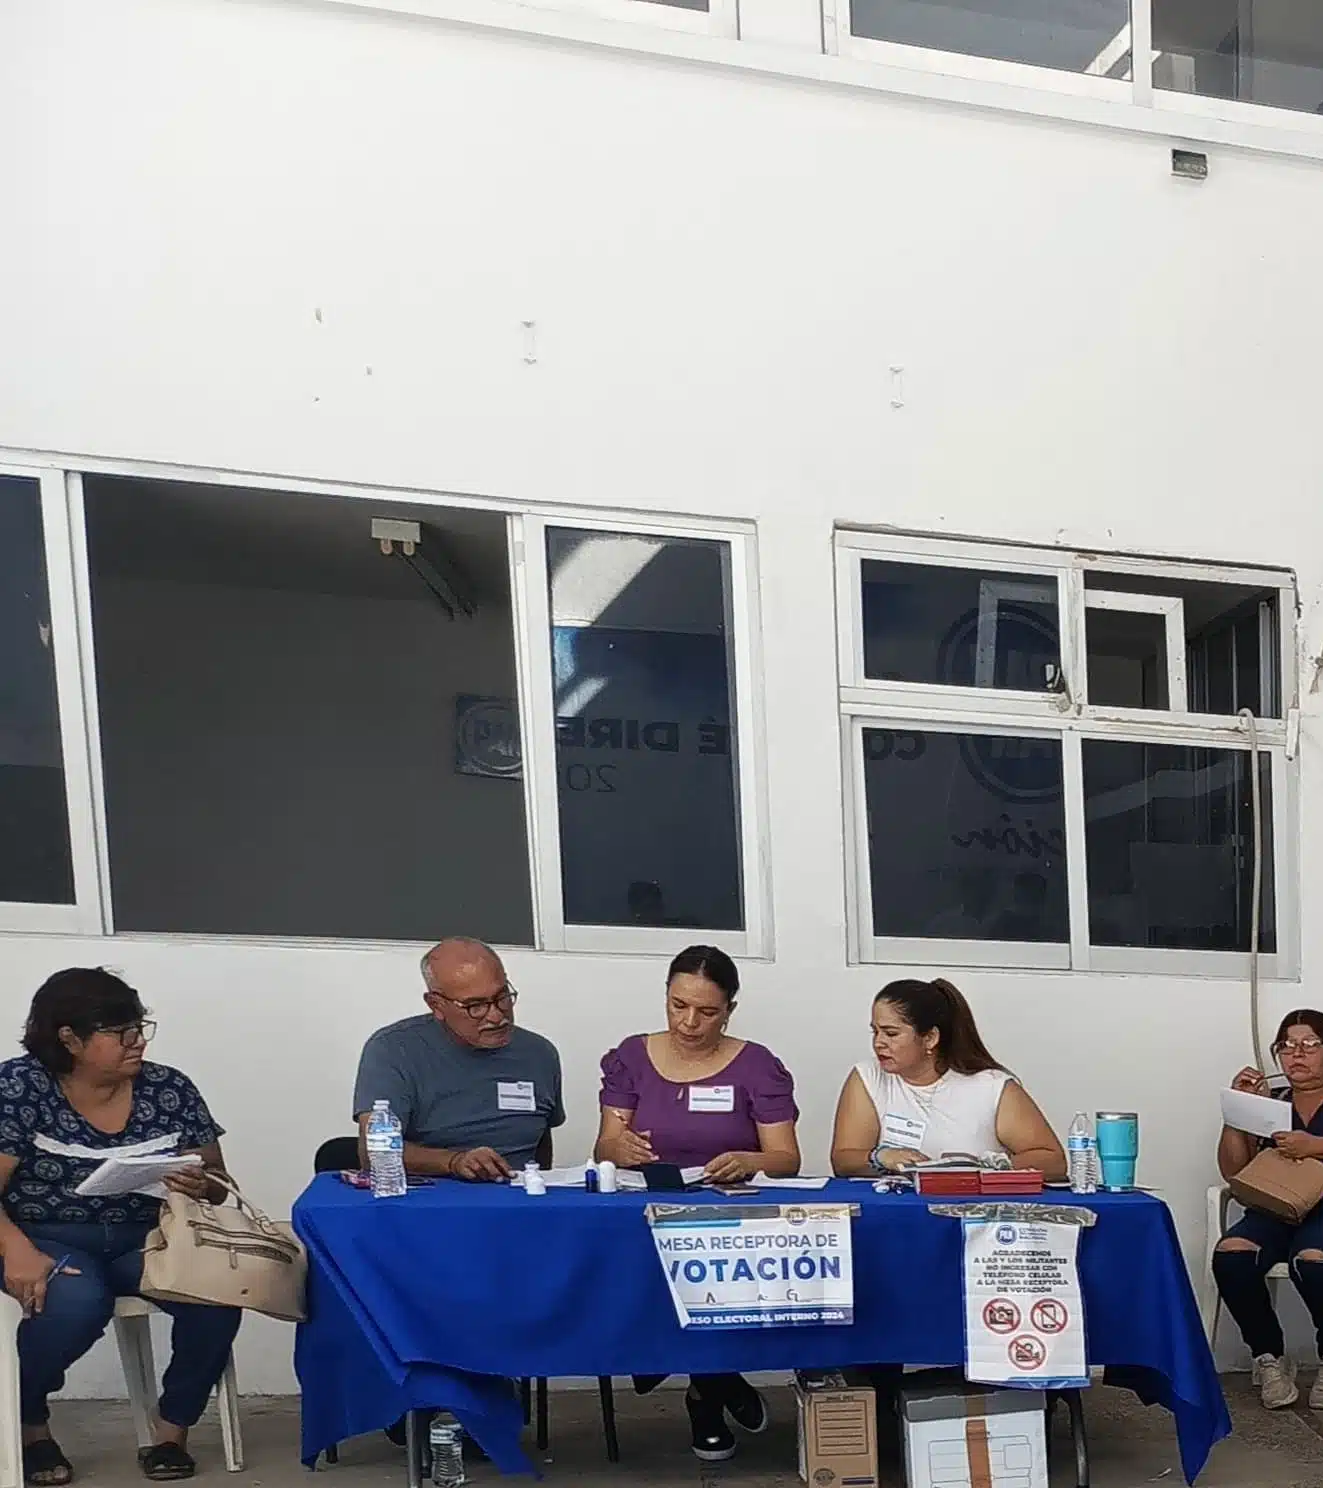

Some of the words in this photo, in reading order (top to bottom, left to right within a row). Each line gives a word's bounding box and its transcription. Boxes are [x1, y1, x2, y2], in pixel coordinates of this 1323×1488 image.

[658, 1236, 706, 1252] MESA
[709, 1234, 811, 1250] RECEPTORA
[815, 1233, 839, 1248] DE
[713, 1314, 773, 1325] ELECTORAL
[774, 1312, 819, 1322] INTERNO
